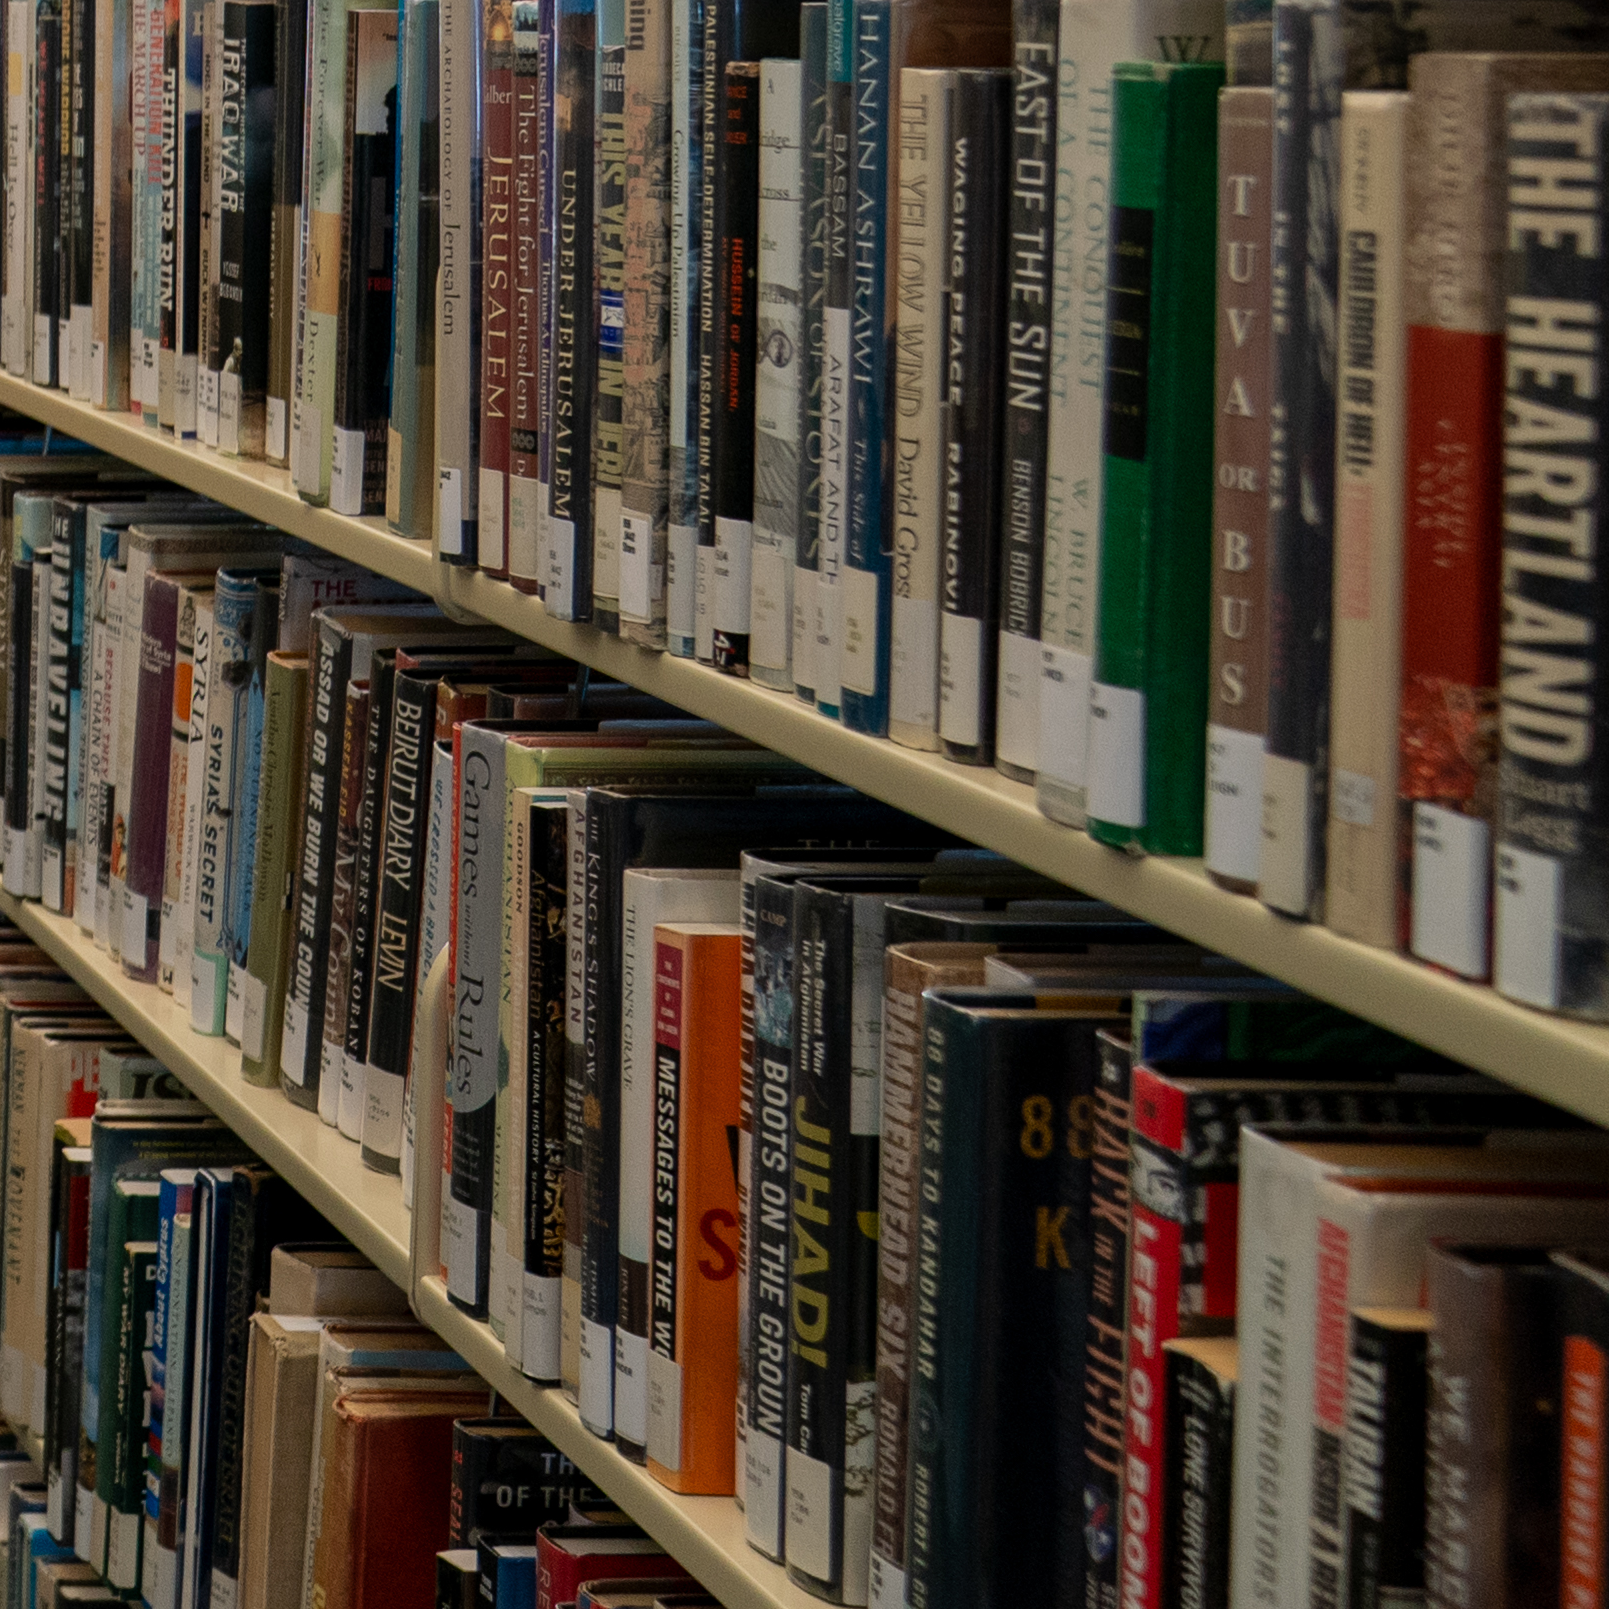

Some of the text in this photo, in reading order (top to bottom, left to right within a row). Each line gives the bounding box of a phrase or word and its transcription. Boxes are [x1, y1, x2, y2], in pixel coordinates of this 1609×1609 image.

[133, 129, 145, 156] UP
[134, 42, 146, 118] MARCH
[147, 8, 162, 184] GENERATION KILL
[221, 37, 241, 213] IRAQ WAR
[314, 57, 329, 207] Forever War
[441, 2, 461, 336] THE ARCHAEOLOGY OF Jerusalem
[701, 4, 716, 333] PALESTINIAN SELF-DETERMINATION
[160, 67, 177, 313] THUNDER RUN
[486, 146, 514, 419] JERUSALEM
[513, 84, 536, 420] The Fight for Jerusalem
[597, 111, 625, 398] THIS YEAR IN
[831, 133, 848, 259] BASSAM
[852, 13, 879, 385] HANAN ASHRAWI
[895, 93, 928, 418] THE YELLOW WIND
[1005, 40, 1055, 408] EAST OF THE SUN
[554, 169, 577, 518] UNDER JERUSALEM
[1503, 109, 1603, 767] THE HEARTLAND
[698, 354, 712, 527] HASSAN BIN TALAL
[826, 354, 842, 543] ARAFAT AND
[896, 435, 922, 518] David
[1010, 459, 1032, 544] BENSON
[87, 688, 103, 845] CHAIN EVENTS
[190, 627, 209, 743] SYRIA
[199, 724, 223, 925] SYRIA'S SECRET
[355, 767, 377, 959] DAUGHTERS OF
[377, 697, 423, 993] BEIRUT DIARY LEVIN
[515, 821, 524, 914] GOODSON
[570, 809, 585, 1025] AFGHANISTAN
[455, 749, 491, 1097] Games without Rules
[528, 870, 547, 1020] Afghanistan
[585, 852, 600, 1084] KING'S SHADOW
[799, 961, 812, 1072] Afghanistan
[760, 1058, 787, 1171] BOOTS
[880, 989, 919, 1380] HAMMERHEAD SIX
[917, 1027, 943, 1380] 88 DAYS TO KANDAHAR
[758, 1243, 786, 1302] THE
[759, 1186, 786, 1236] ON
[791, 1094, 832, 1371] JIHAD!
[1346, 1356, 1383, 1521] TALIBAN
